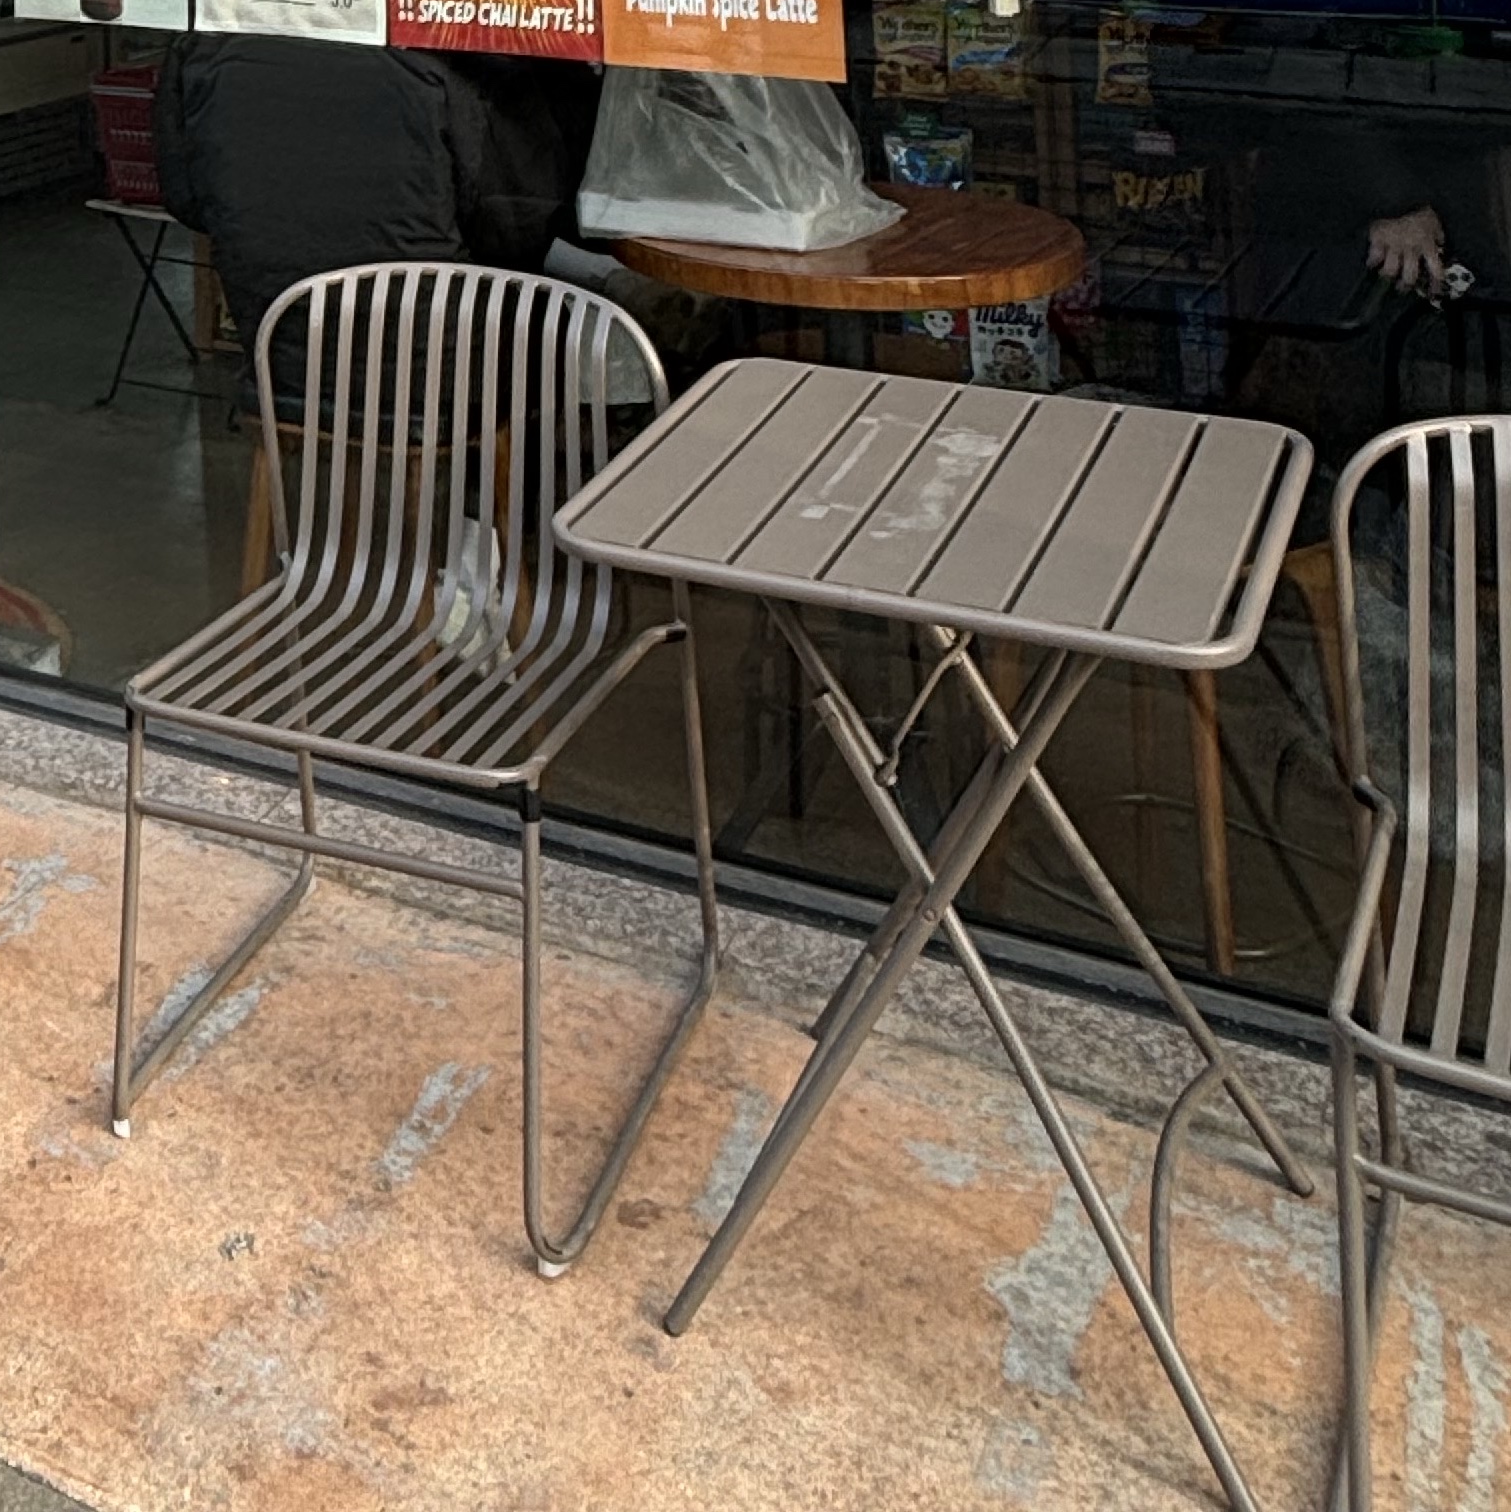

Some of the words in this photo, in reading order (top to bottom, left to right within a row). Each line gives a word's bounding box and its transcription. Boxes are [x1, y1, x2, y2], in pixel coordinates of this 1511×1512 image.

[417, 0, 475, 25] SPICED
[477, 2, 519, 28] CHAI
[519, 4, 575, 31] LATTE
